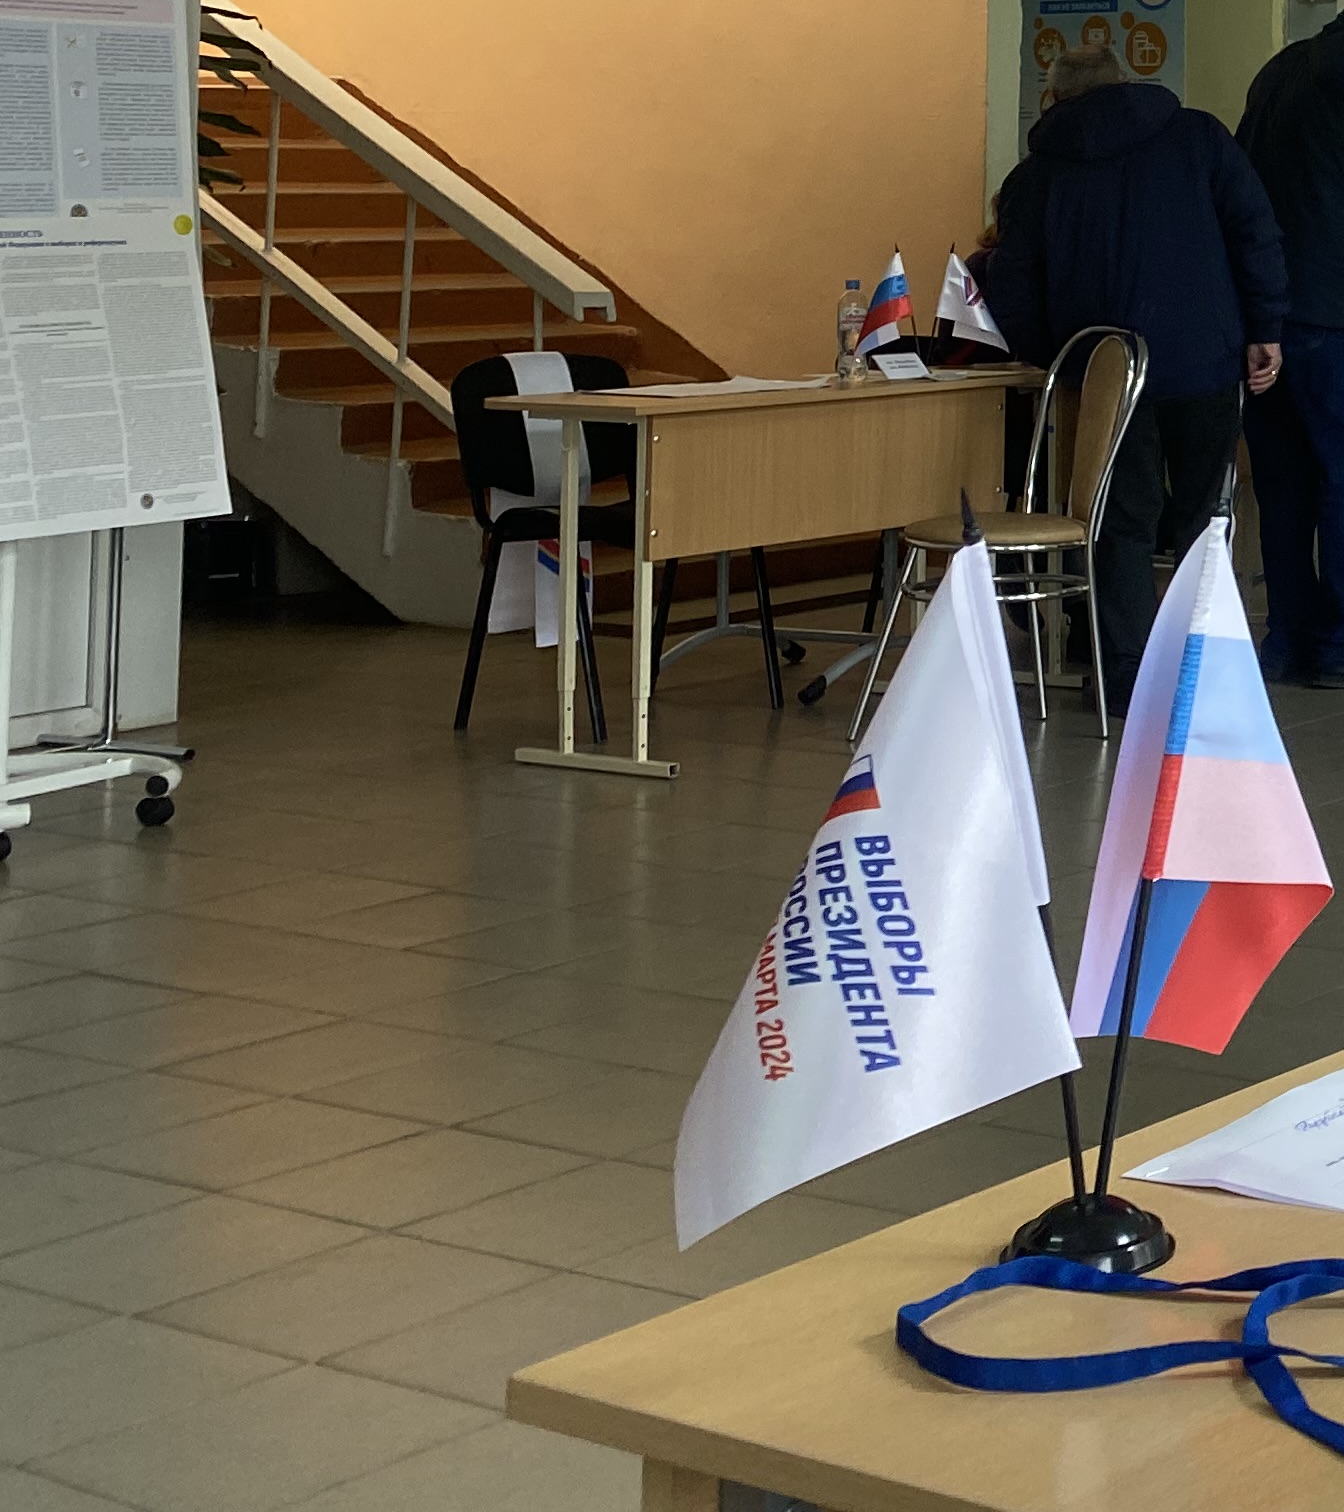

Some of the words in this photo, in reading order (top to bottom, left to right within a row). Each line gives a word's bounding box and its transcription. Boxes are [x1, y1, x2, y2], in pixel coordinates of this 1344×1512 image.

[784, 855, 821, 986] ОССИИ
[816, 840, 901, 1073] ПРЕЗИДЕНТА
[854, 835, 935, 996] ВЫБОРЫ
[756, 1019, 794, 1081] 2024
